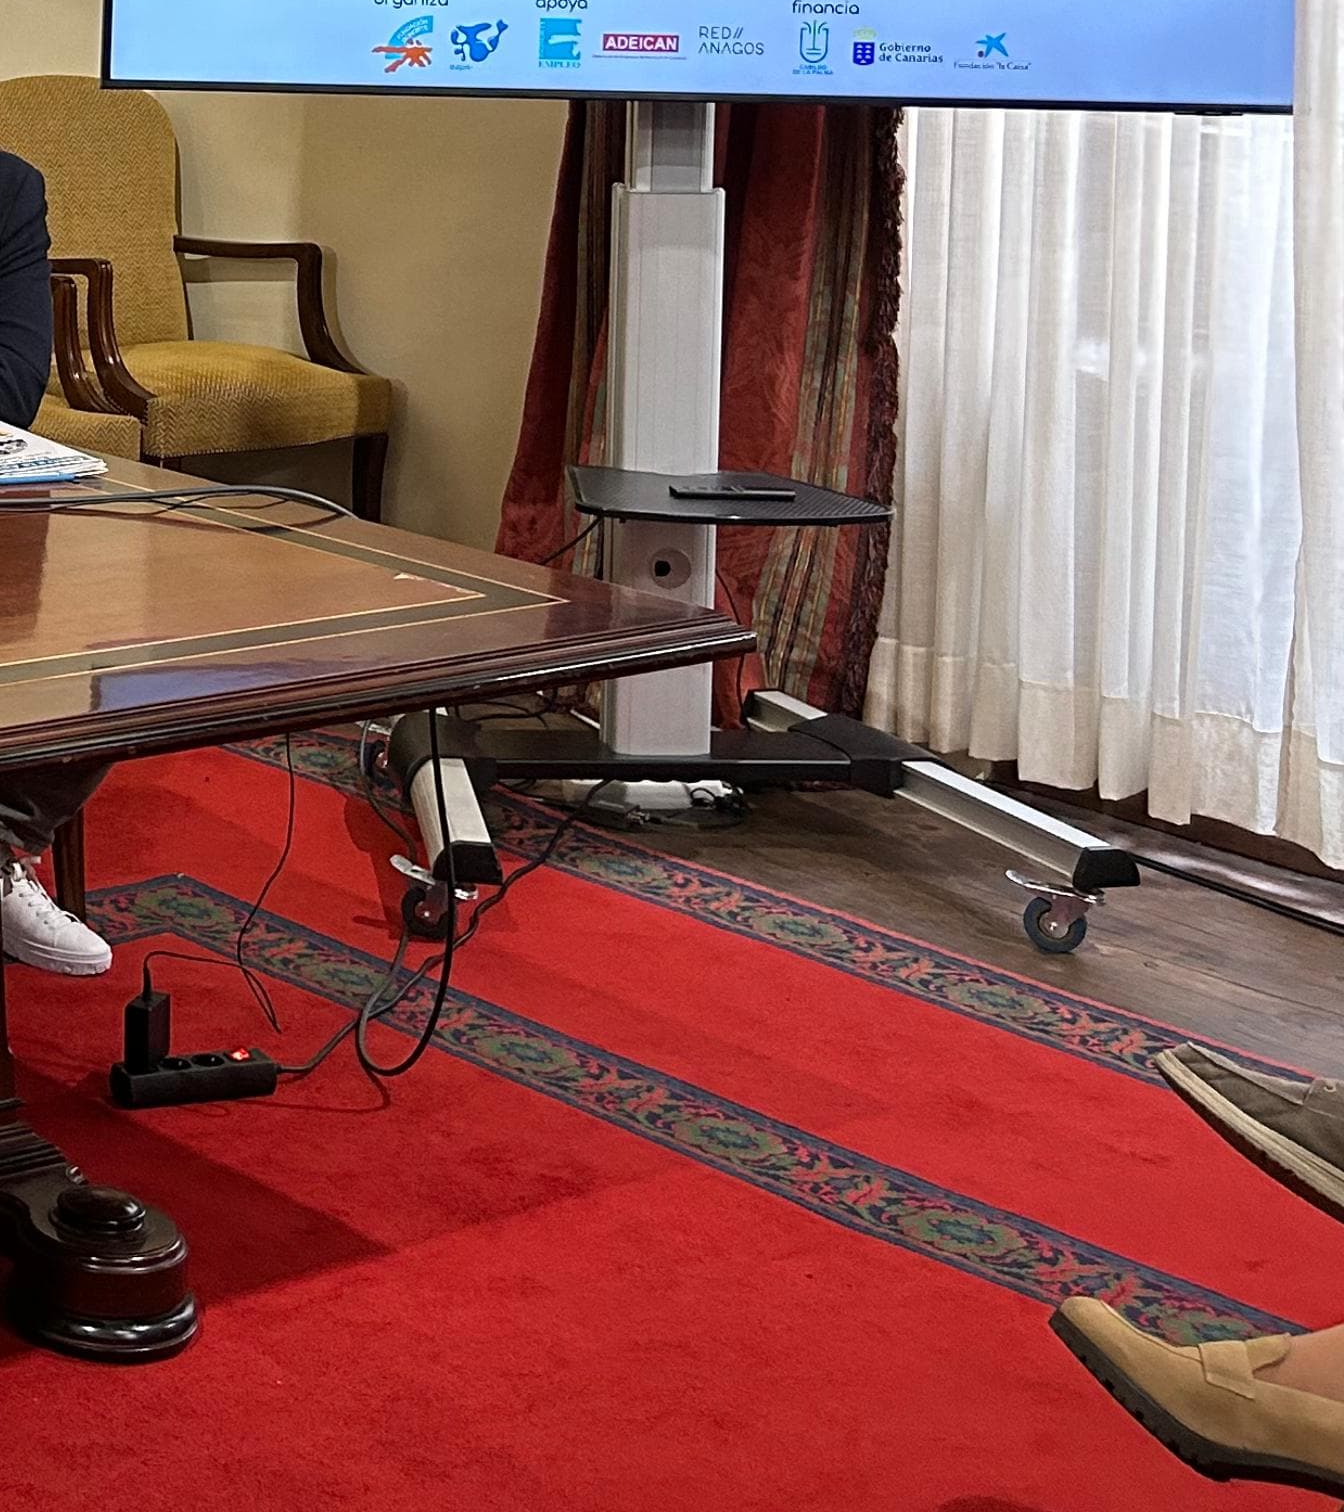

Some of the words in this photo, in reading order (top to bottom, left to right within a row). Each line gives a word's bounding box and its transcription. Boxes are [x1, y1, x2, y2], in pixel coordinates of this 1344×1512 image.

[792, 0, 860, 15] financia
[605, 36, 678, 51] ADEICAN
[698, 42, 765, 56] ANAGOS
[879, 42, 932, 53] Gobierno
[879, 52, 893, 63] de
[894, 52, 944, 64] Canarias
